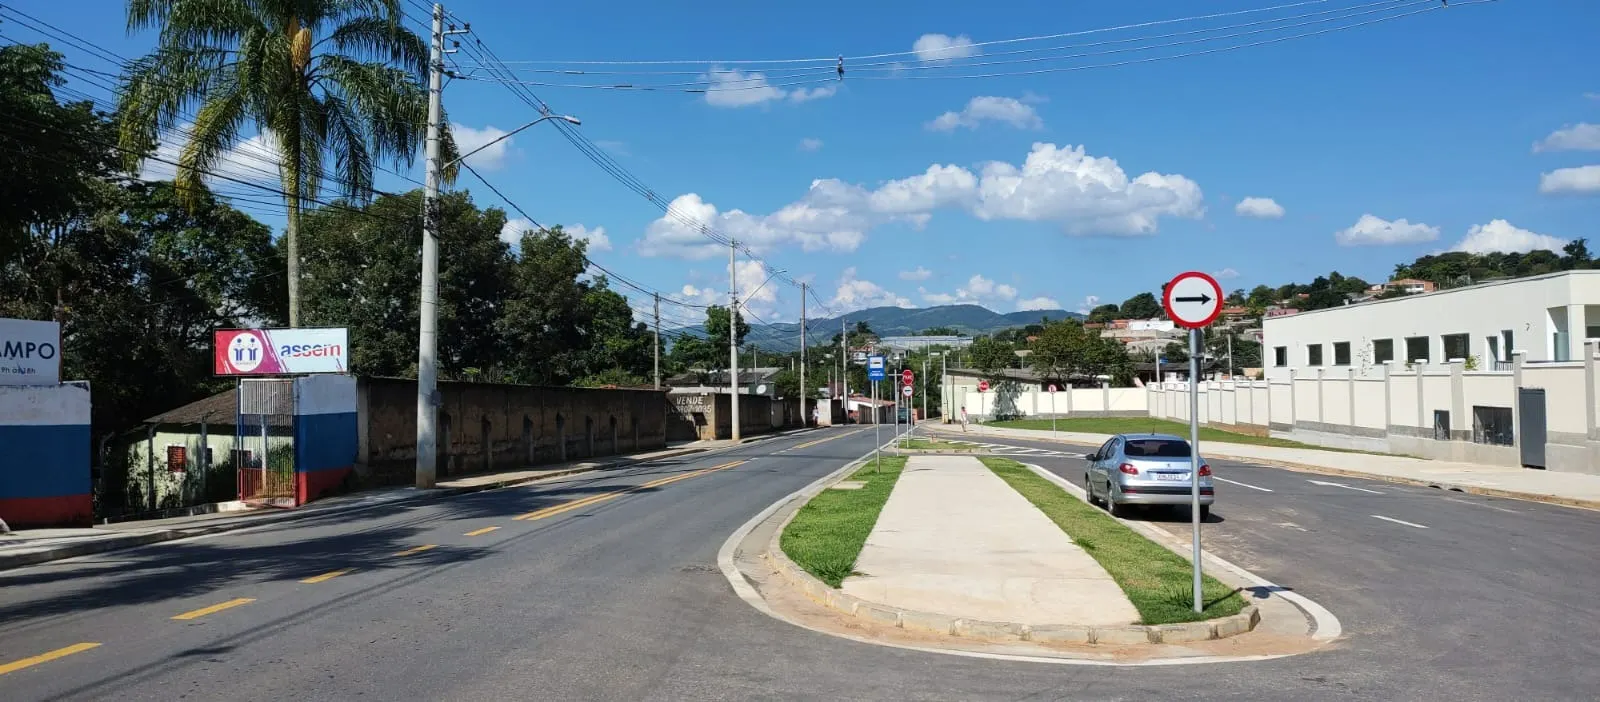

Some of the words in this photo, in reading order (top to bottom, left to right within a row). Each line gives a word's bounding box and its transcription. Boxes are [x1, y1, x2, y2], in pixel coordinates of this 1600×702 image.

[0, 341, 55, 360] MPO
[281, 344, 341, 358] assem
[676, 396, 704, 405] VENDE
